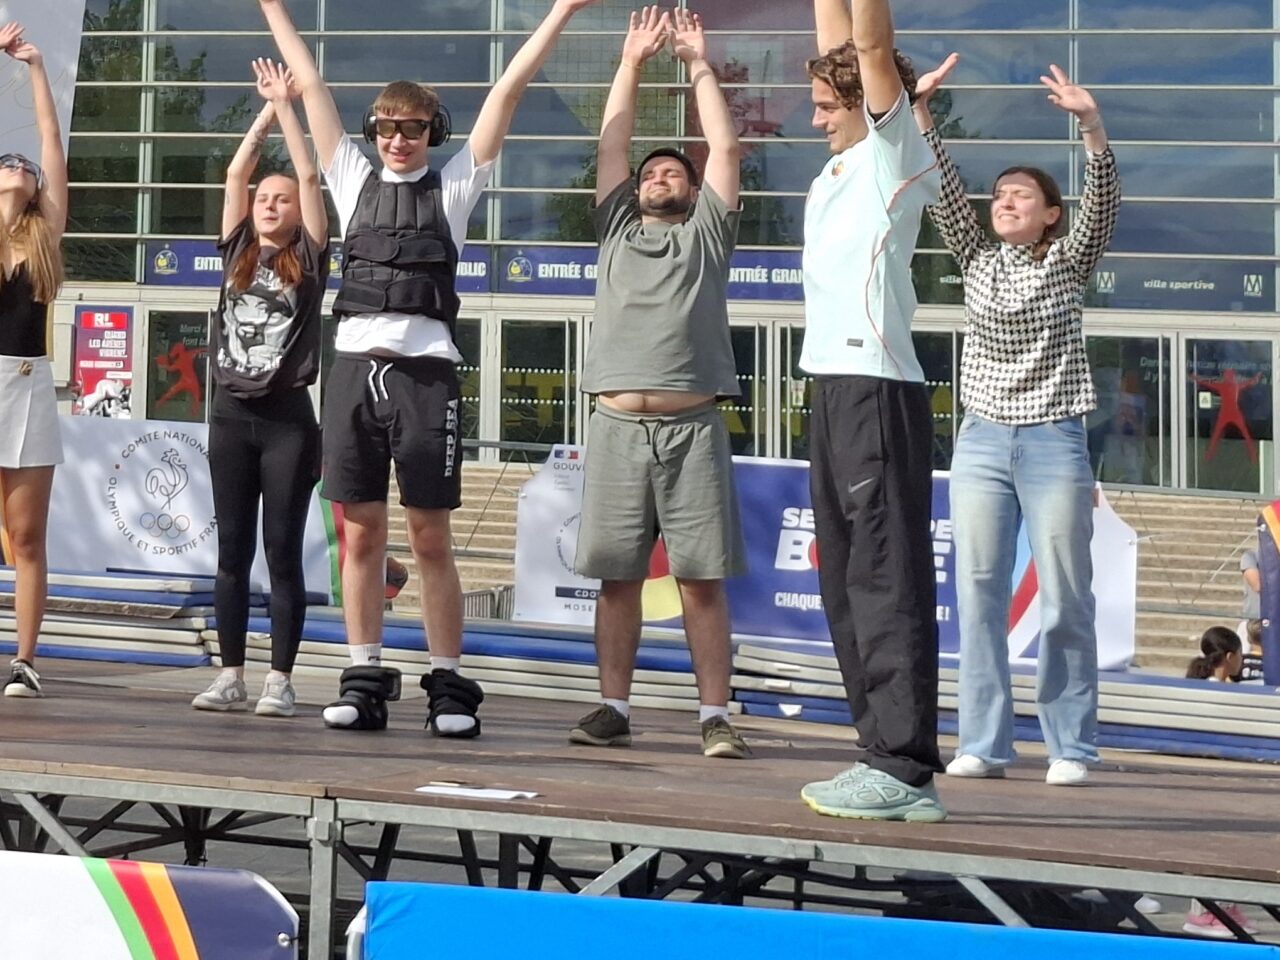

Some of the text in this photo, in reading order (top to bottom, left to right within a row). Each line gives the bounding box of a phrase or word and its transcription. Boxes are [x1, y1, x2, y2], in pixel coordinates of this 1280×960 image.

[538, 261, 582, 279] ENTRÉE
[728, 265, 769, 283] NTRÉE
[1144, 280, 1167, 290] ville
[444, 398, 459, 477] DEEP SEA
[107, 476, 136, 543] OLYMPIQUE
[137, 539, 149, 552] ET
[152, 538, 198, 555] SPORTIF
[574, 589, 600, 599] CDO
